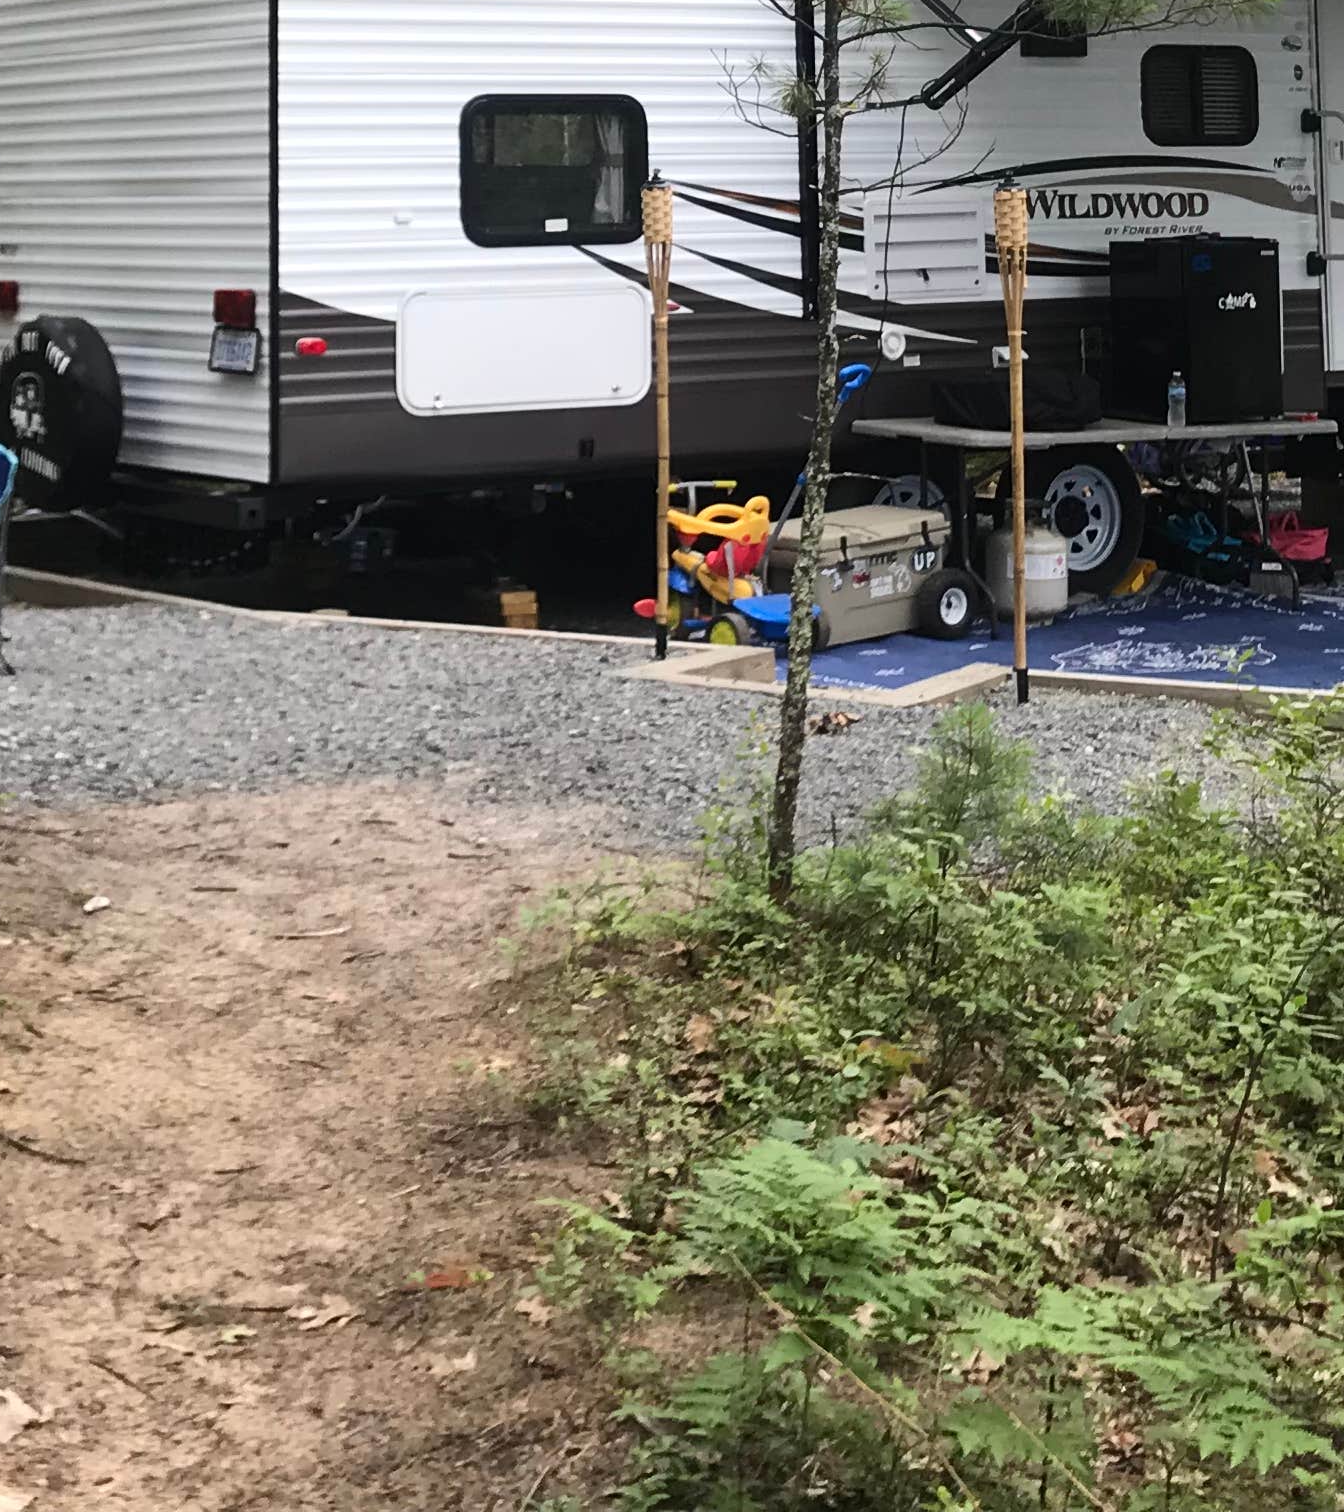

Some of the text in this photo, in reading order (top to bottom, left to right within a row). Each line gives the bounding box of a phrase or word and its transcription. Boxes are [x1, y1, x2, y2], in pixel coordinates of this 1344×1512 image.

[1025, 189, 1209, 220] WILDWOOD
[1104, 224, 1204, 236] BY FOREST RIVER
[913, 551, 936, 571] UP
